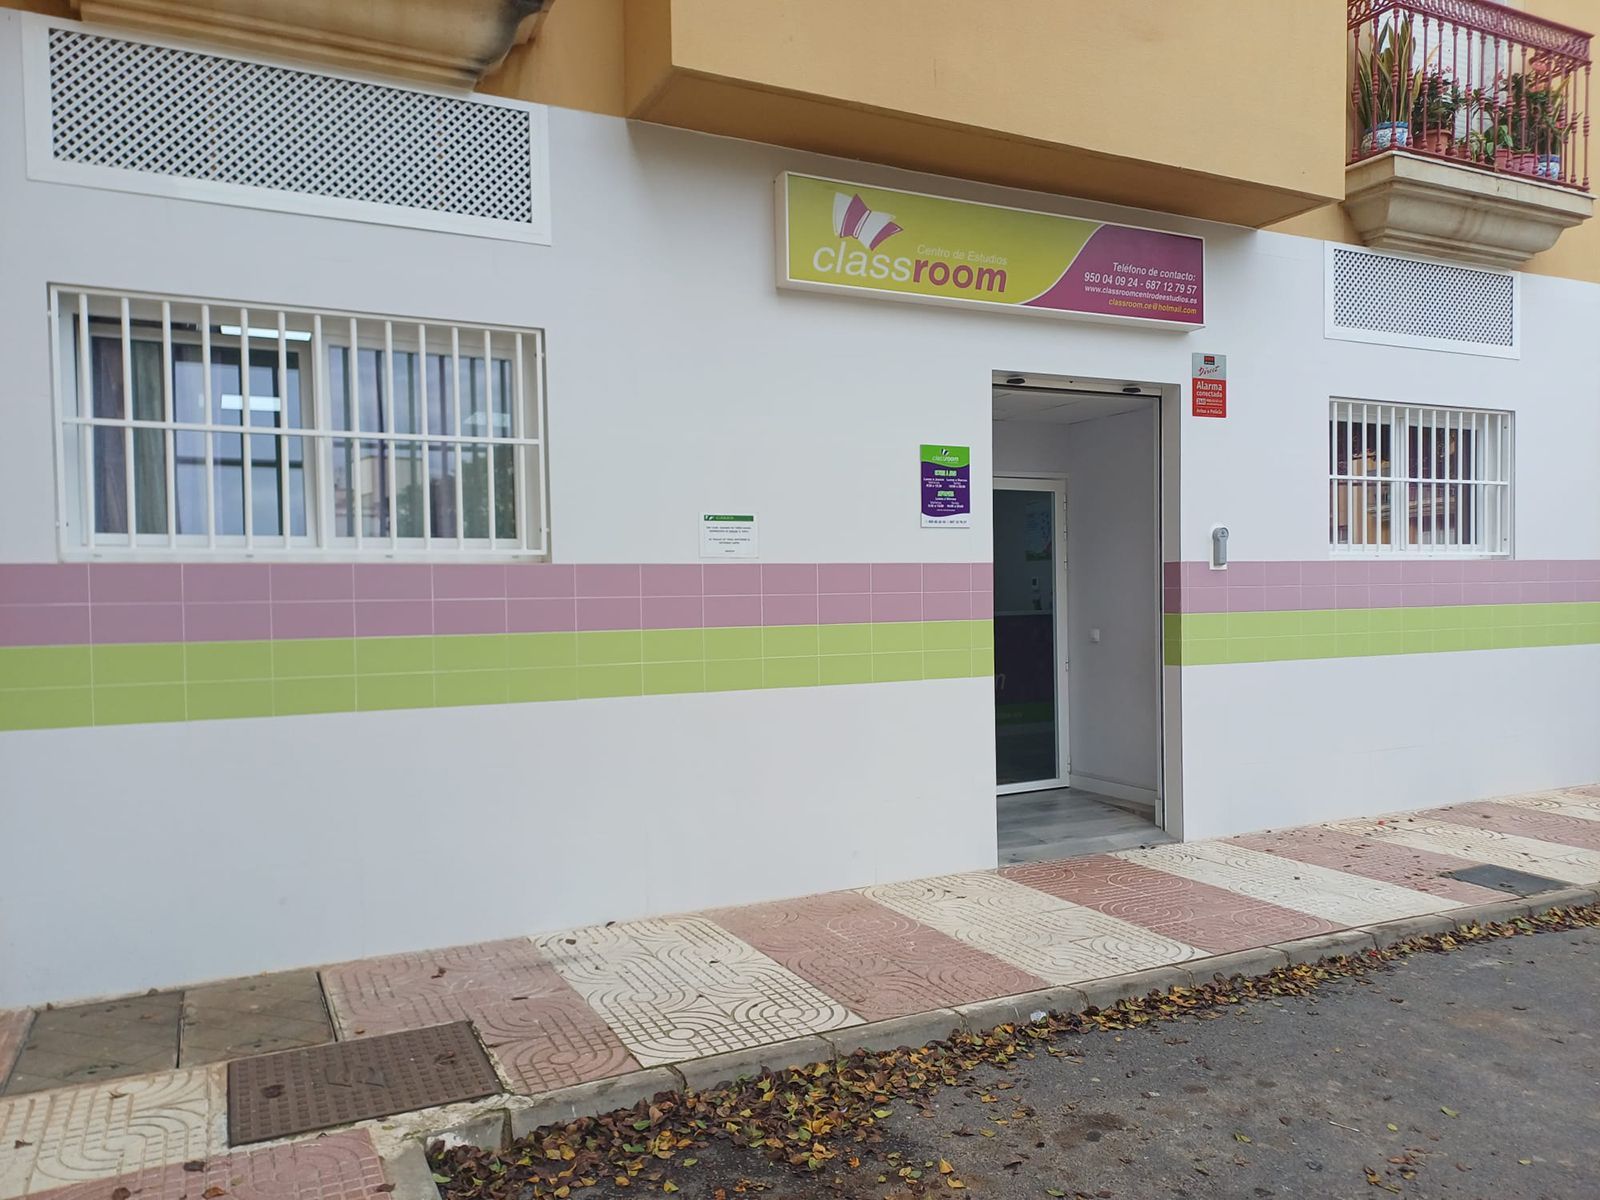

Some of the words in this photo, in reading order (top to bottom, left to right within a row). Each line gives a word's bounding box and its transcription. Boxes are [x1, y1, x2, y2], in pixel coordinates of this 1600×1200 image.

[917, 244, 950, 258] Centro
[953, 249, 965, 260] de
[967, 251, 1008, 265] Estudios
[813, 241, 1007, 293] classroom
[1113, 262, 1146, 276] Teléfono
[1148, 268, 1158, 277] de
[1160, 270, 1196, 281] contacto:
[1084, 272, 1100, 282] 950
[1103, 274, 1113, 283] 04
[1115, 276, 1125, 286] 09
[1127, 278, 1138, 287] 24
[1145, 280, 1161, 290] 687
[1163, 282, 1173, 292] 12
[1175, 283, 1185, 293] 79
[1186, 284, 1197, 295] 57
[1085, 285, 1198, 304] www.classroomcentrodeestudios.es
[1109, 298, 1197, 314] classroom.ce@hotmail.com
[1196, 381, 1222, 391] Alarma
[1196, 390, 1222, 398] conectada
